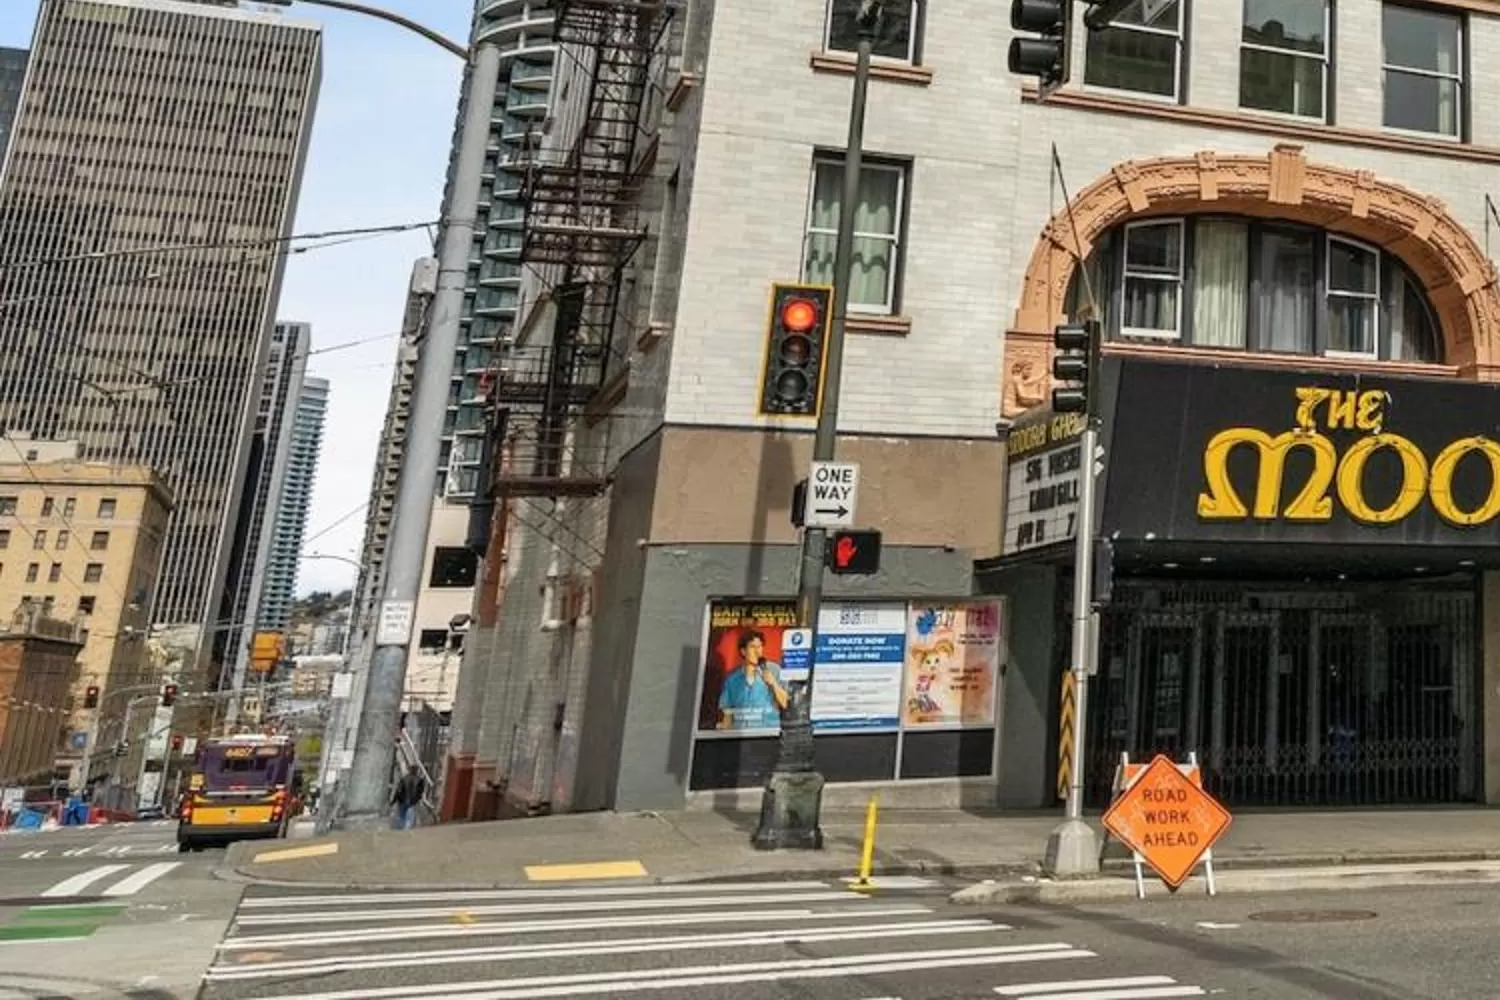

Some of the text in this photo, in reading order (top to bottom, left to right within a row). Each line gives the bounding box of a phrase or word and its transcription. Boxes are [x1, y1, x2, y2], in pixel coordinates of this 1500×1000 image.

[1294, 386, 1387, 430] THE
[815, 467, 853, 483] ONE
[815, 485, 852, 500] WAY
[1142, 789, 1187, 803] ROAD
[1144, 810, 1190, 824] WORK
[1143, 831, 1199, 847] AHEAD
